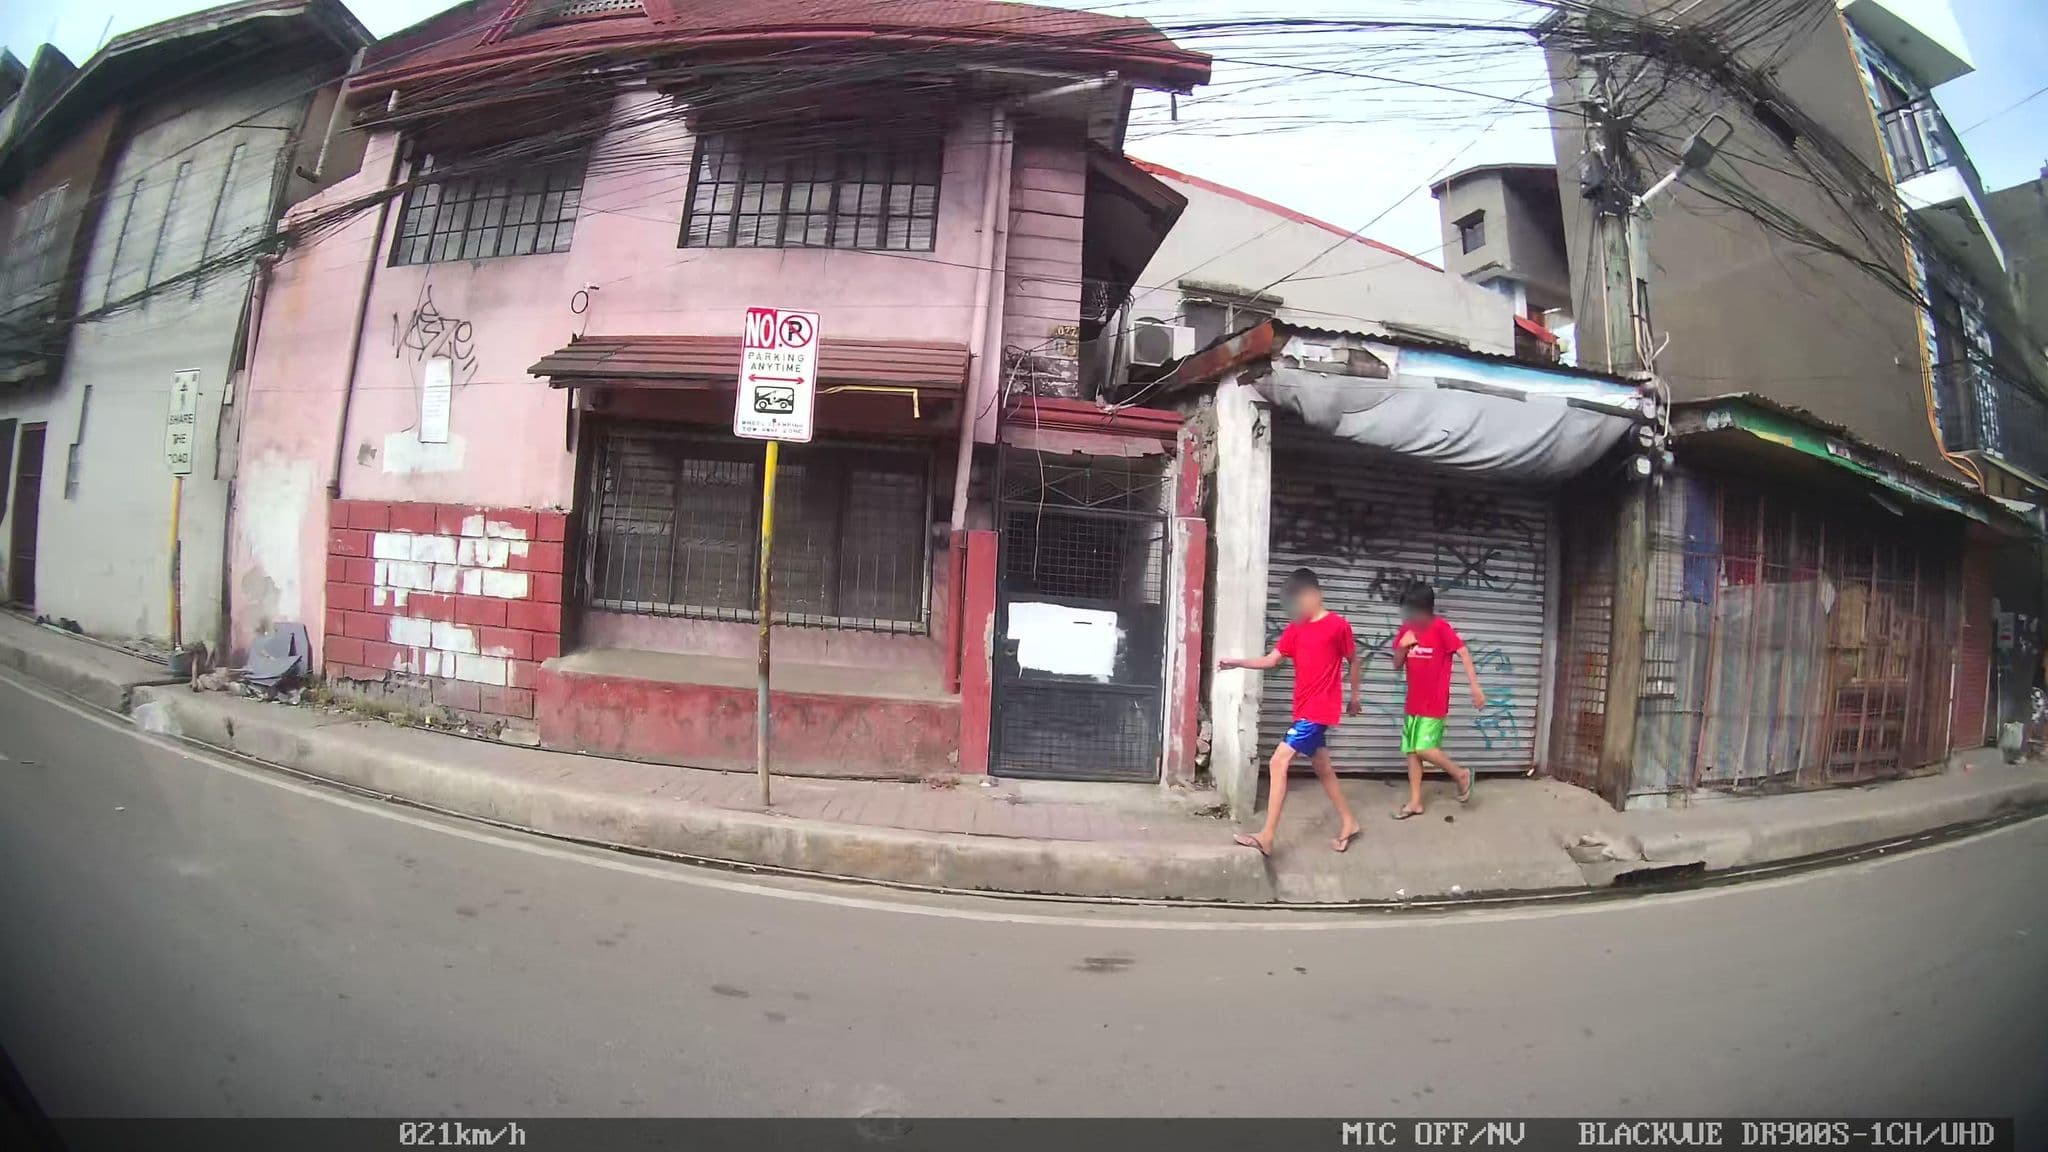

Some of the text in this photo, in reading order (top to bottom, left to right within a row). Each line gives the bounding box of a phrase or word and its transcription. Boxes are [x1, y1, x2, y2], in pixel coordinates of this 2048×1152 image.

[745, 311, 776, 349] NO
[747, 351, 805, 363] PARKING
[750, 362, 802, 373] ANYTIME
[169, 413, 193, 425] SHARE
